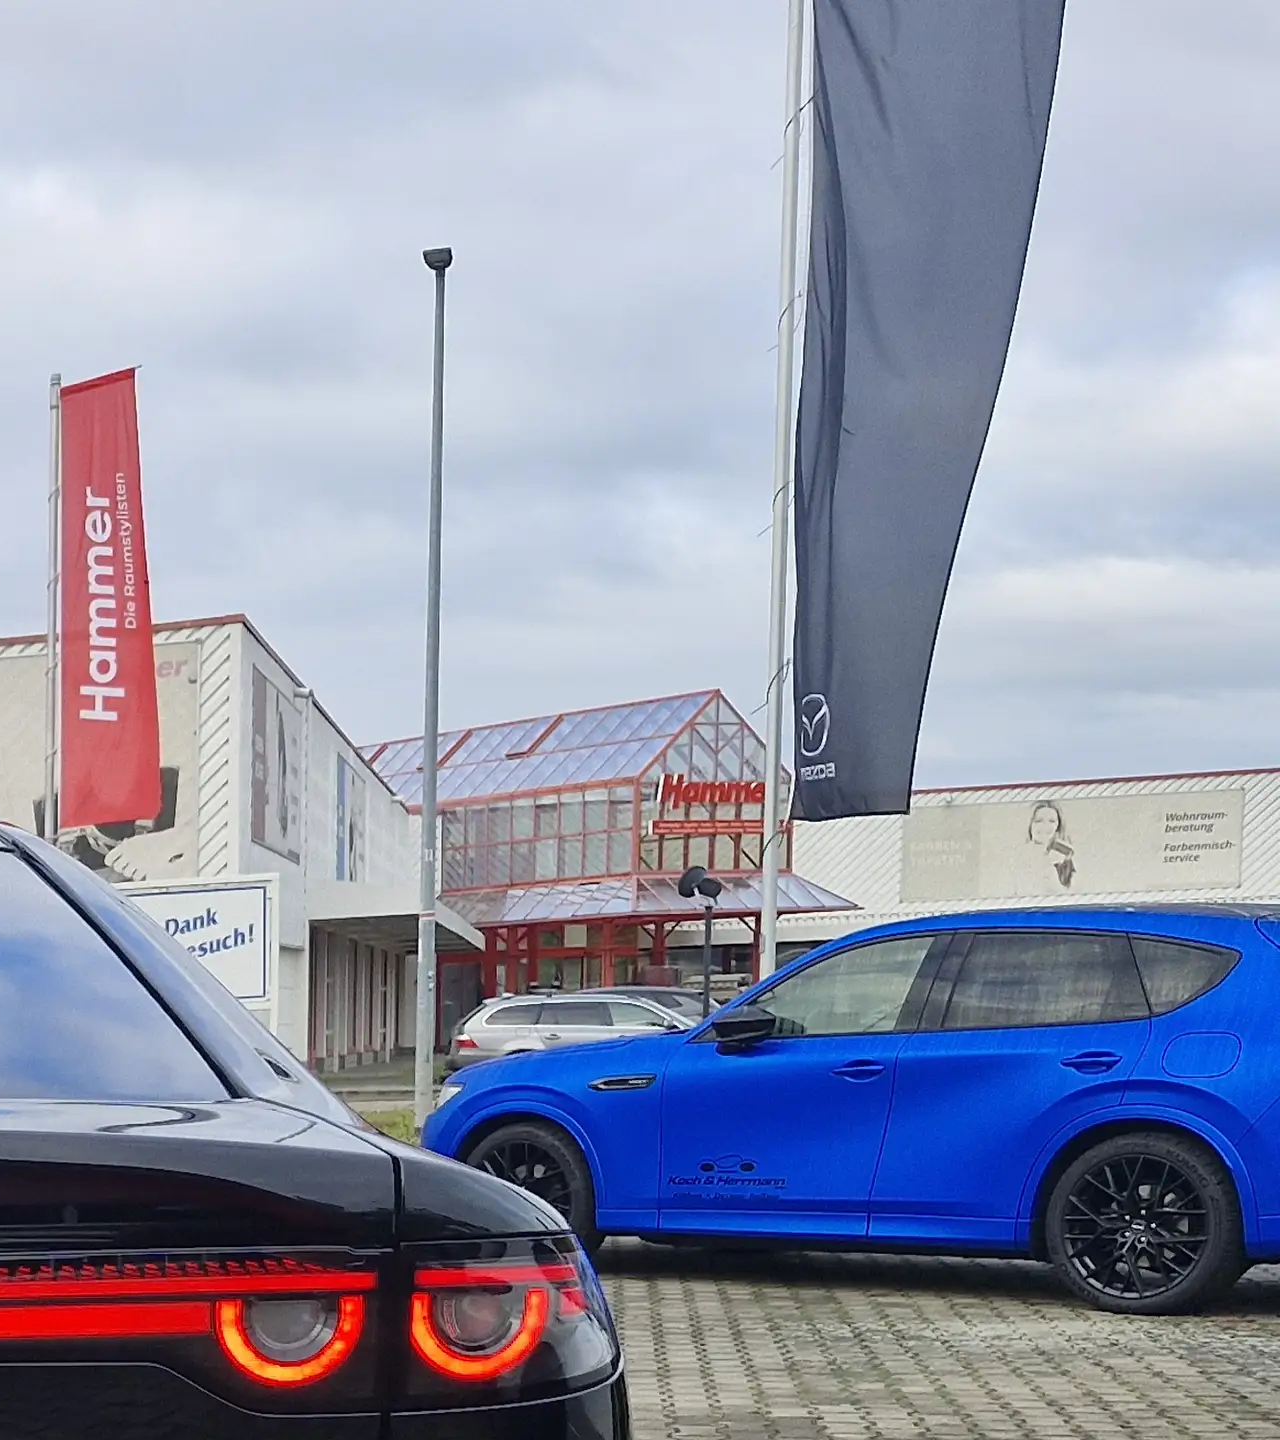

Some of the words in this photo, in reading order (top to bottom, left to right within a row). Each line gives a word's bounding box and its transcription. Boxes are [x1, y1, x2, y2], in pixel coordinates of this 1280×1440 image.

[116, 472, 136, 597] Raumstylisten
[79, 486, 126, 722] Hammer
[125, 601, 137, 630] Die
[661, 773, 767, 810] Hamme
[1164, 820, 1214, 834] beratung
[1165, 811, 1228, 823] Wohnraum-
[1163, 839, 1237, 853] Farbenmisch-
[1163, 851, 1201, 864] service
[165, 906, 218, 938] Dank
[186, 924, 255, 958] esuch!
[667, 1175, 702, 1186] Koch
